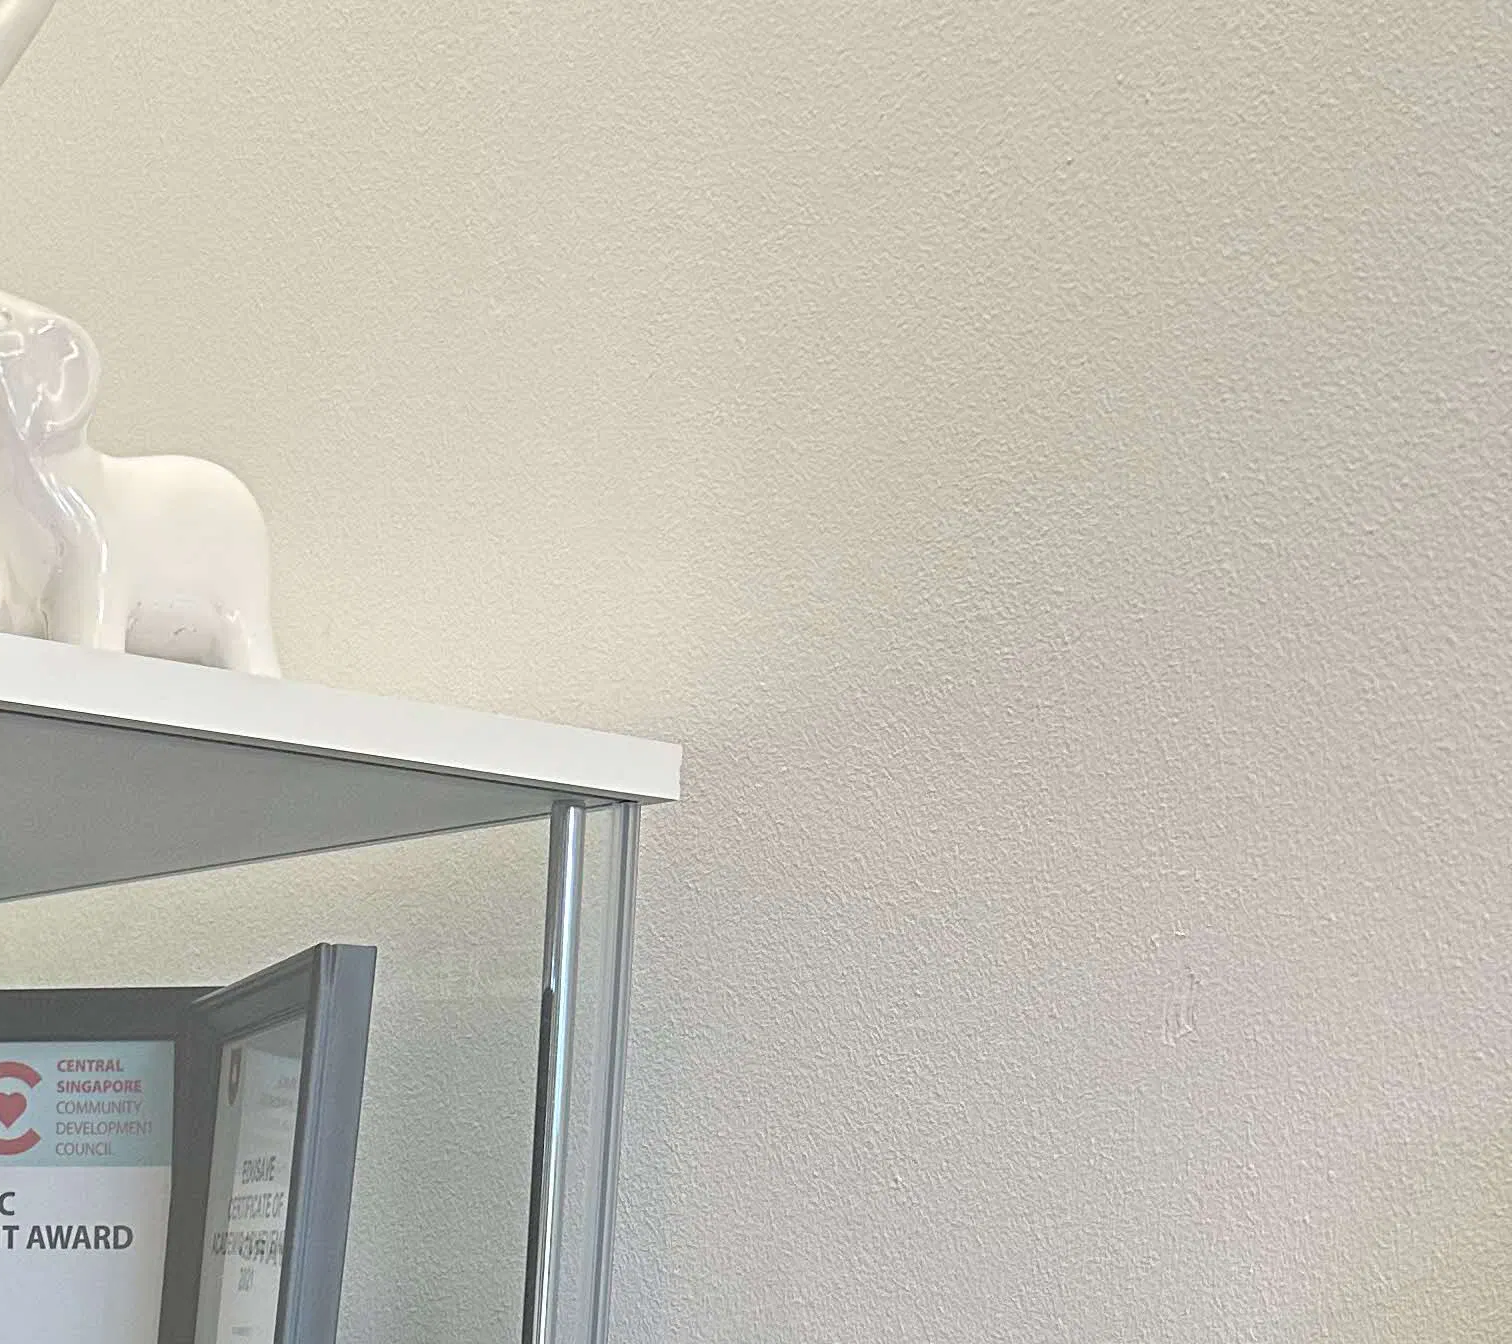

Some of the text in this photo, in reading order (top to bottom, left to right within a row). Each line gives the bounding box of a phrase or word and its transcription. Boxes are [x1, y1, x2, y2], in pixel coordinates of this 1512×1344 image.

[56, 1059, 124, 1073] CENTRAL
[56, 1080, 142, 1093] SINGAPORE
[56, 1101, 141, 1114] COMMUNITY
[56, 1121, 153, 1135] DEVELOPMENT
[55, 1142, 112, 1156] COUNCIL
[26, 1225, 133, 1249] AWARD
